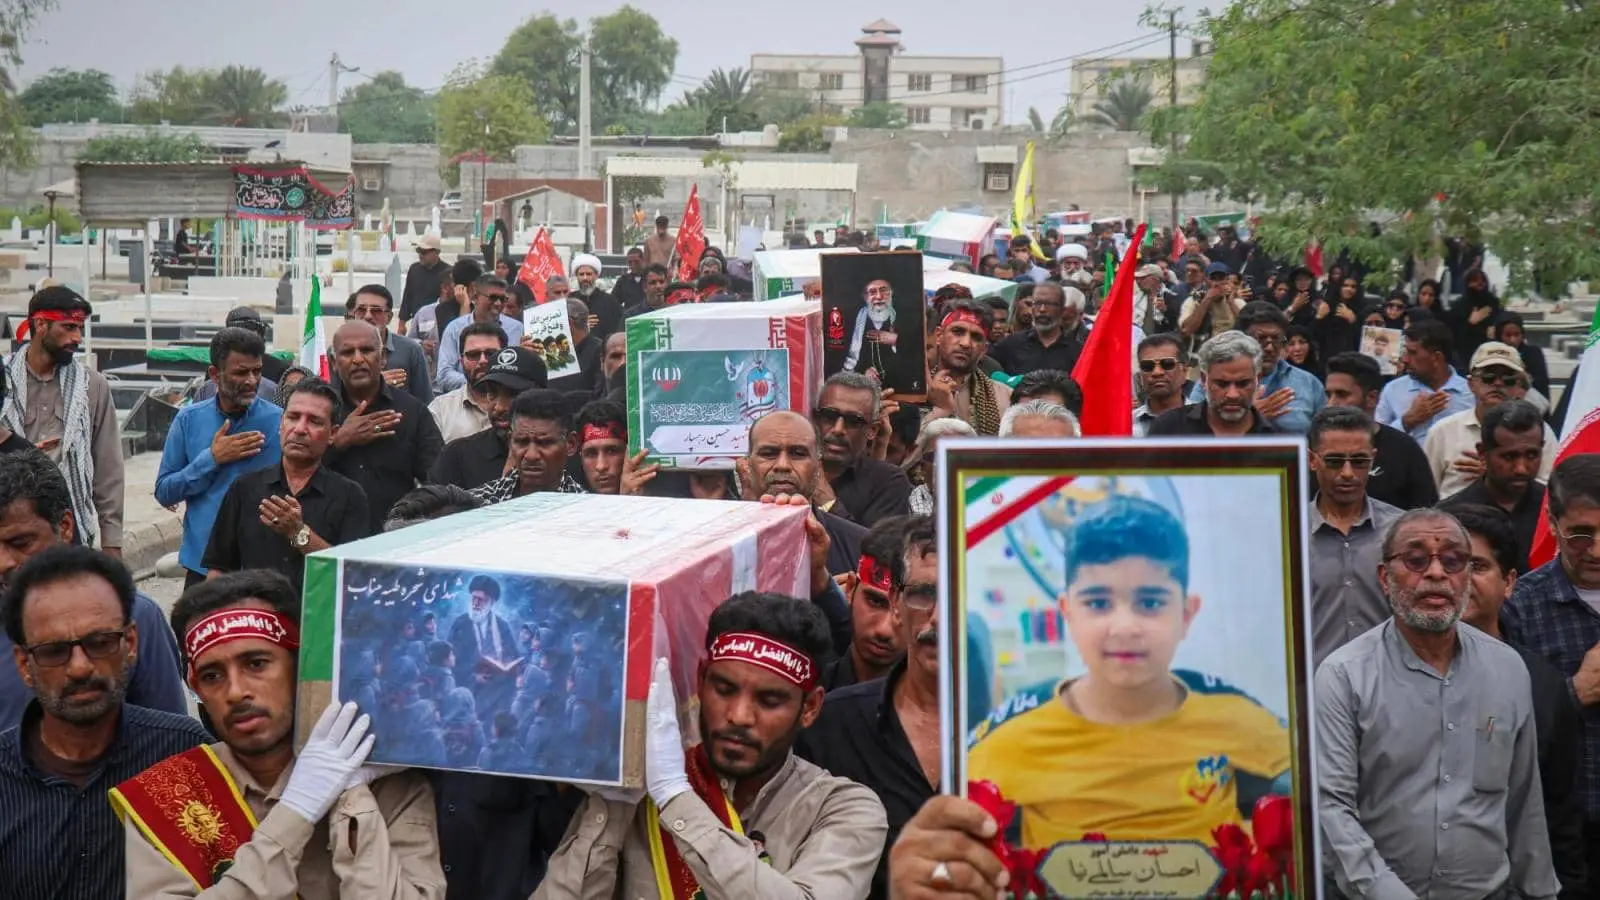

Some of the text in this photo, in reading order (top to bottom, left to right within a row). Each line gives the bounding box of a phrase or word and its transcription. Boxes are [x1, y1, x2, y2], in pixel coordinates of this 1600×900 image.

[347, 567, 463, 606] شهدای شجره طیبه میناب
[718, 638, 755, 655] العباس
[1142, 846, 1169, 857] شهید
[1135, 857, 1200, 883] احسان
